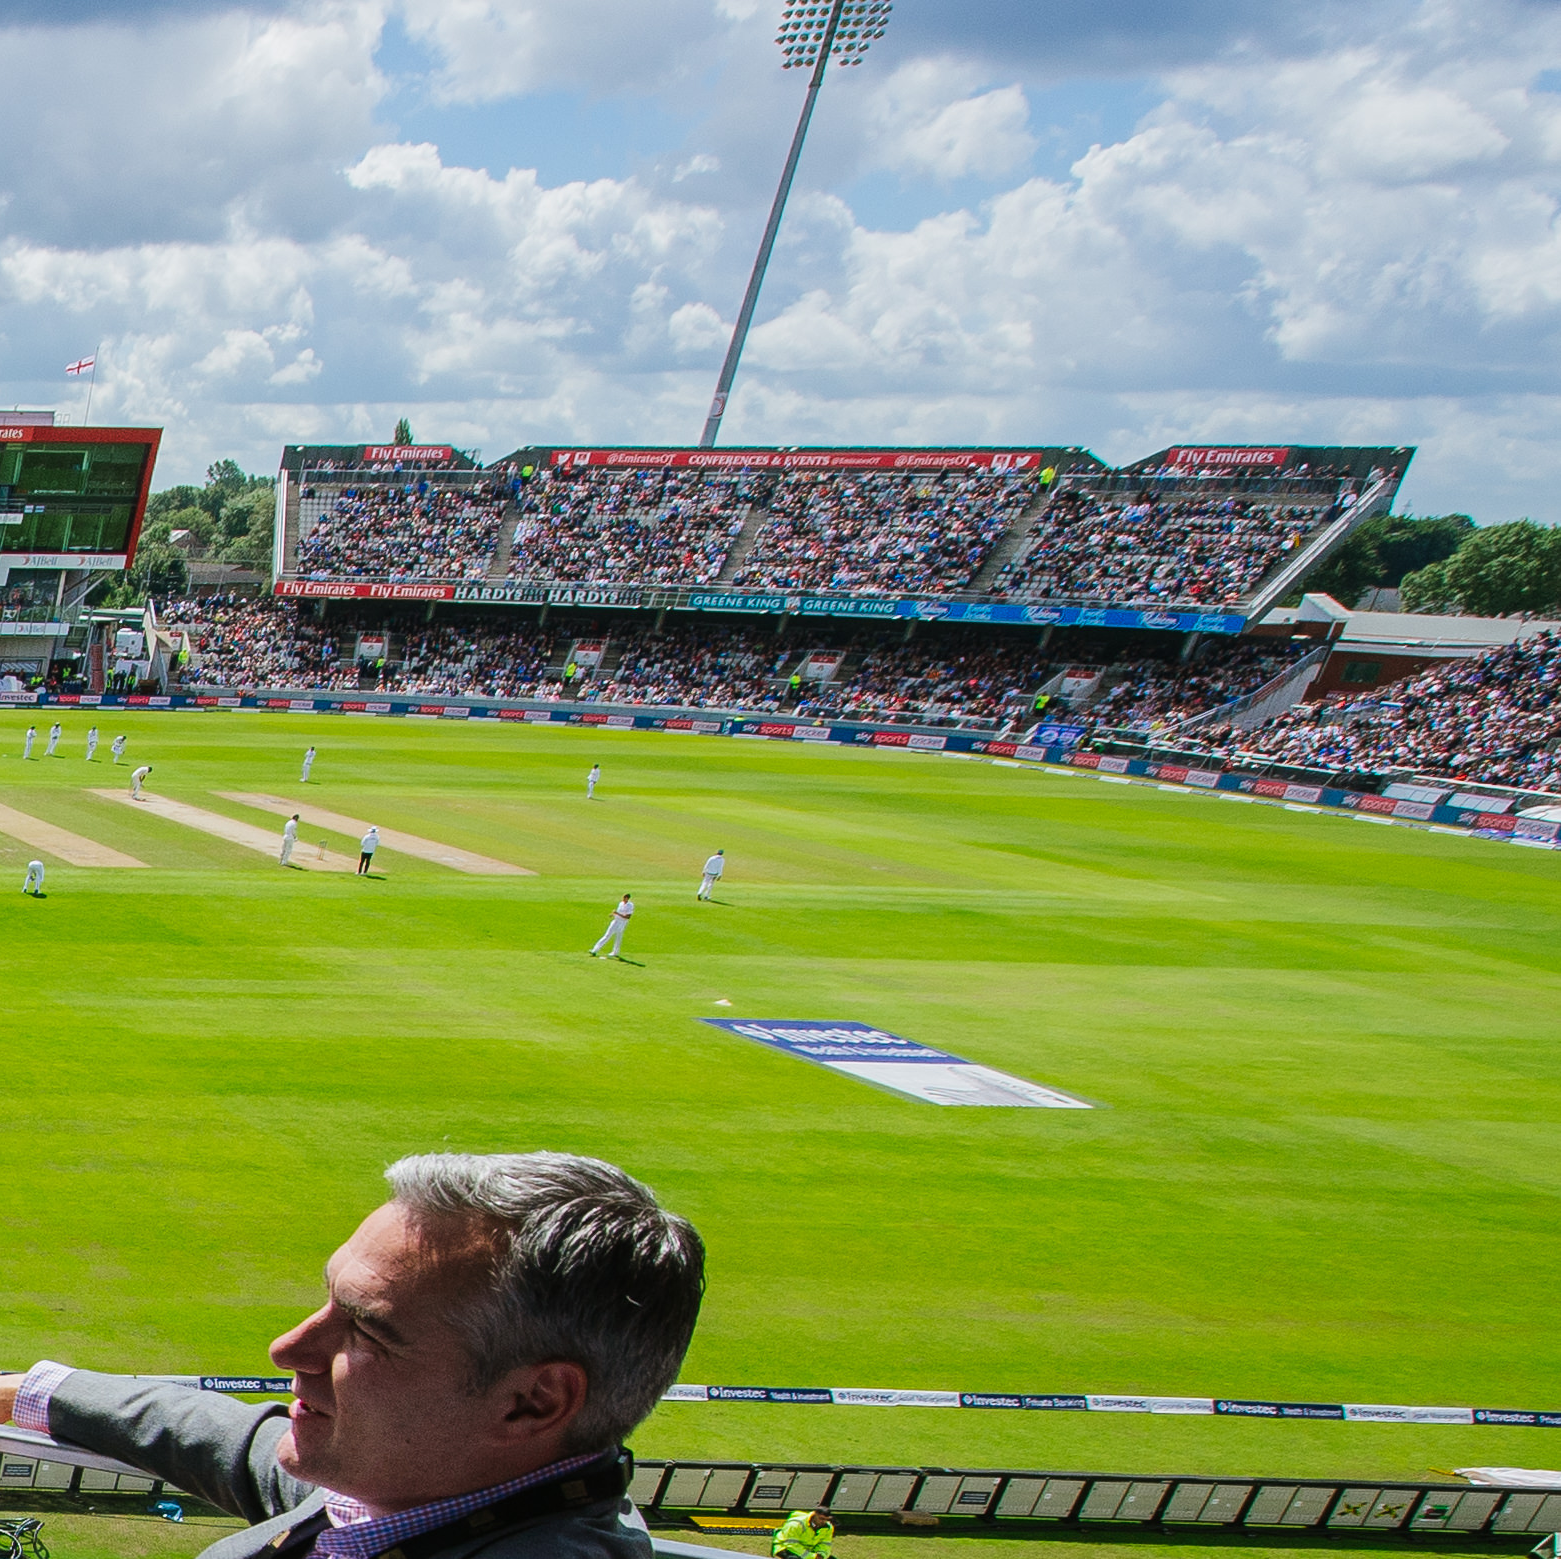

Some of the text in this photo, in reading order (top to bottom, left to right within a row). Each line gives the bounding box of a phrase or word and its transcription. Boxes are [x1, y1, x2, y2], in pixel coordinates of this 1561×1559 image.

[371, 448, 443, 460] Fly Emirates
[607, 453, 675, 464] @EmiratesOT
[1177, 450, 1275, 466] Fly Emirates
[689, 456, 830, 466] CONFERENCES EVENTS
[894, 456, 972, 467] @EmiratesOT
[283, 583, 356, 596] Fly Emirates
[370, 585, 445, 598] Fly Emirates
[694, 596, 894, 614] GREENE KING GREENE KING
[0, 693, 33, 701] Investec
[760, 726, 828, 738] sports cricket
[875, 734, 946, 748] sports cricket
[988, 743, 1015, 756] sports
[215, 1378, 260, 1390] Investec
[720, 1387, 767, 1399] Investec
[974, 1395, 1020, 1407] Investec
[1228, 1402, 1277, 1414] Investec
[1487, 1412, 1536, 1423] Investec
